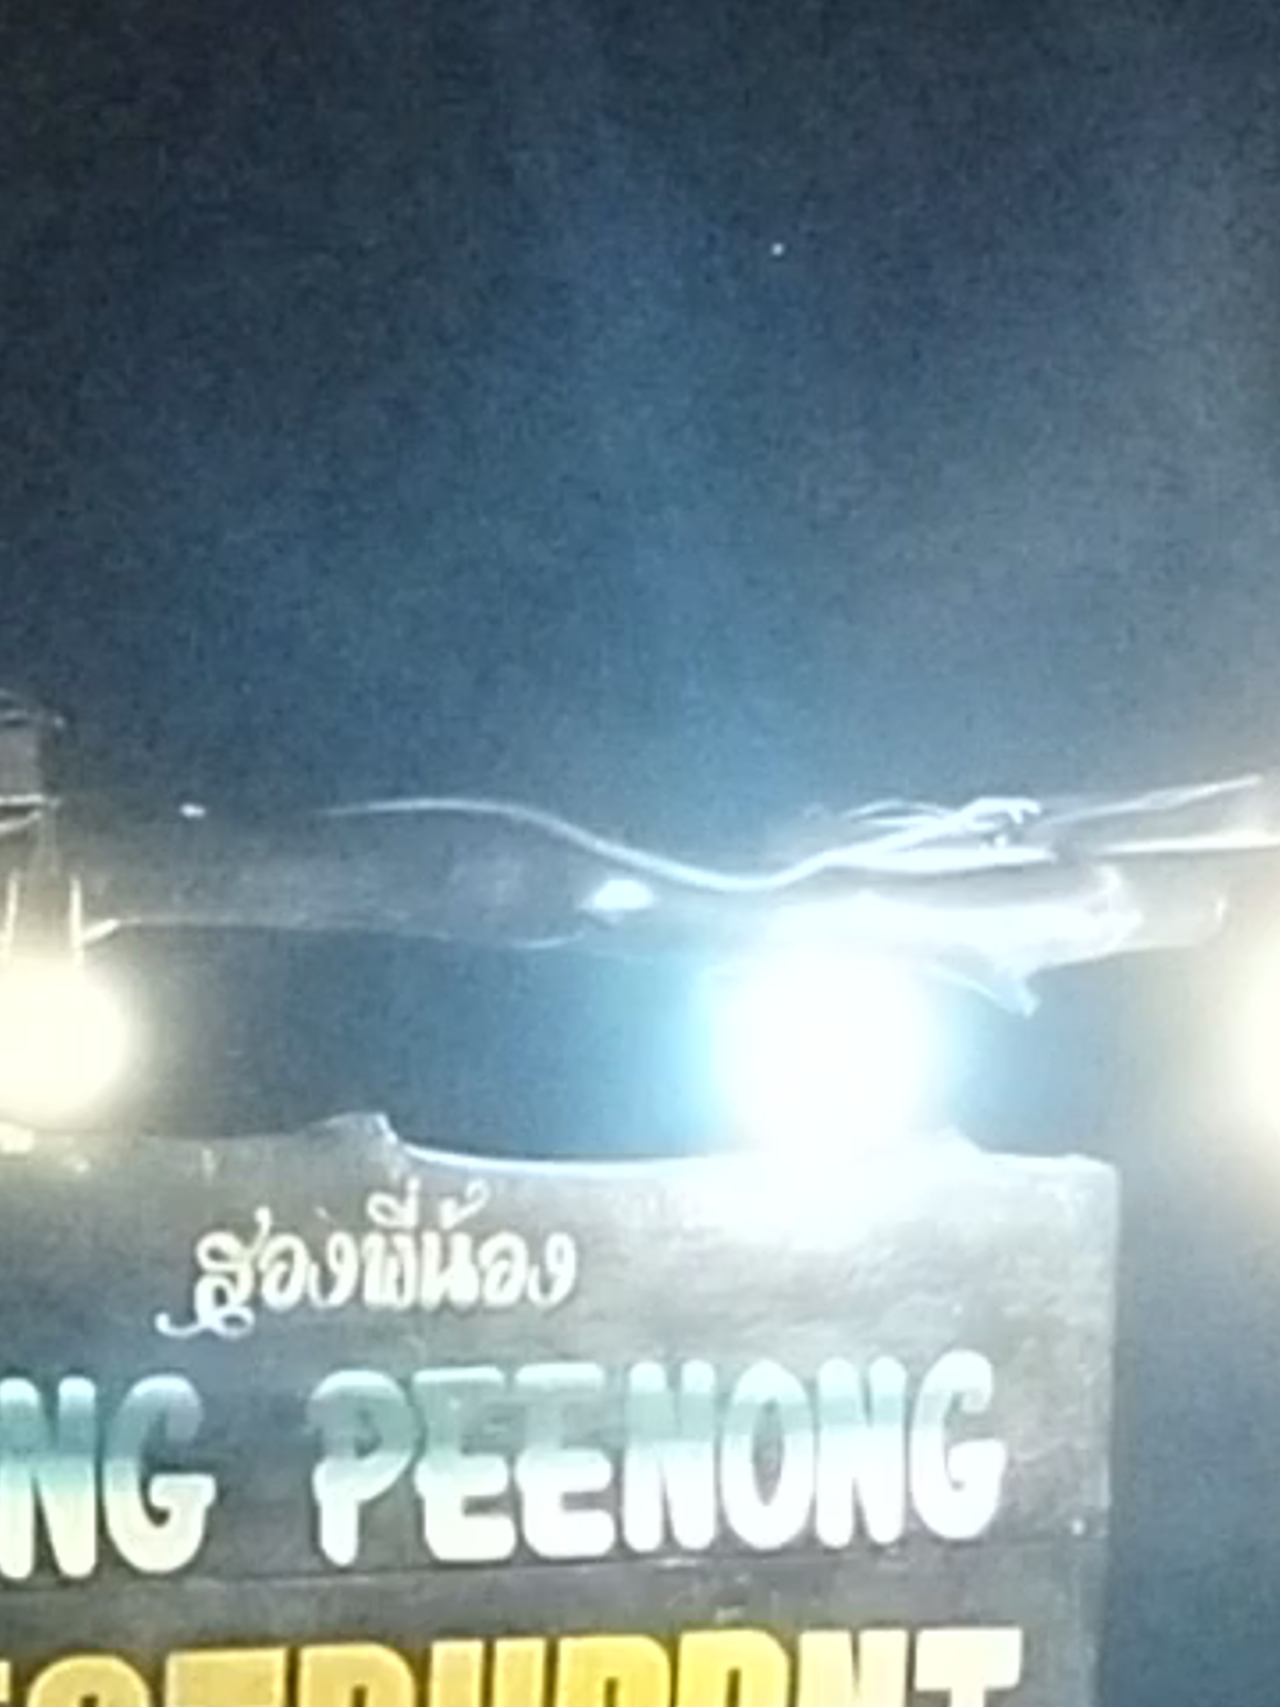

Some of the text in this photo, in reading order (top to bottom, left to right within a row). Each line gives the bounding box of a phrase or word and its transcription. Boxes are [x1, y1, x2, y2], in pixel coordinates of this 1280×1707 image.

[154, 1178, 577, 1339] สองพี่น้อง
[312, 1351, 1008, 1567] PEENONG
